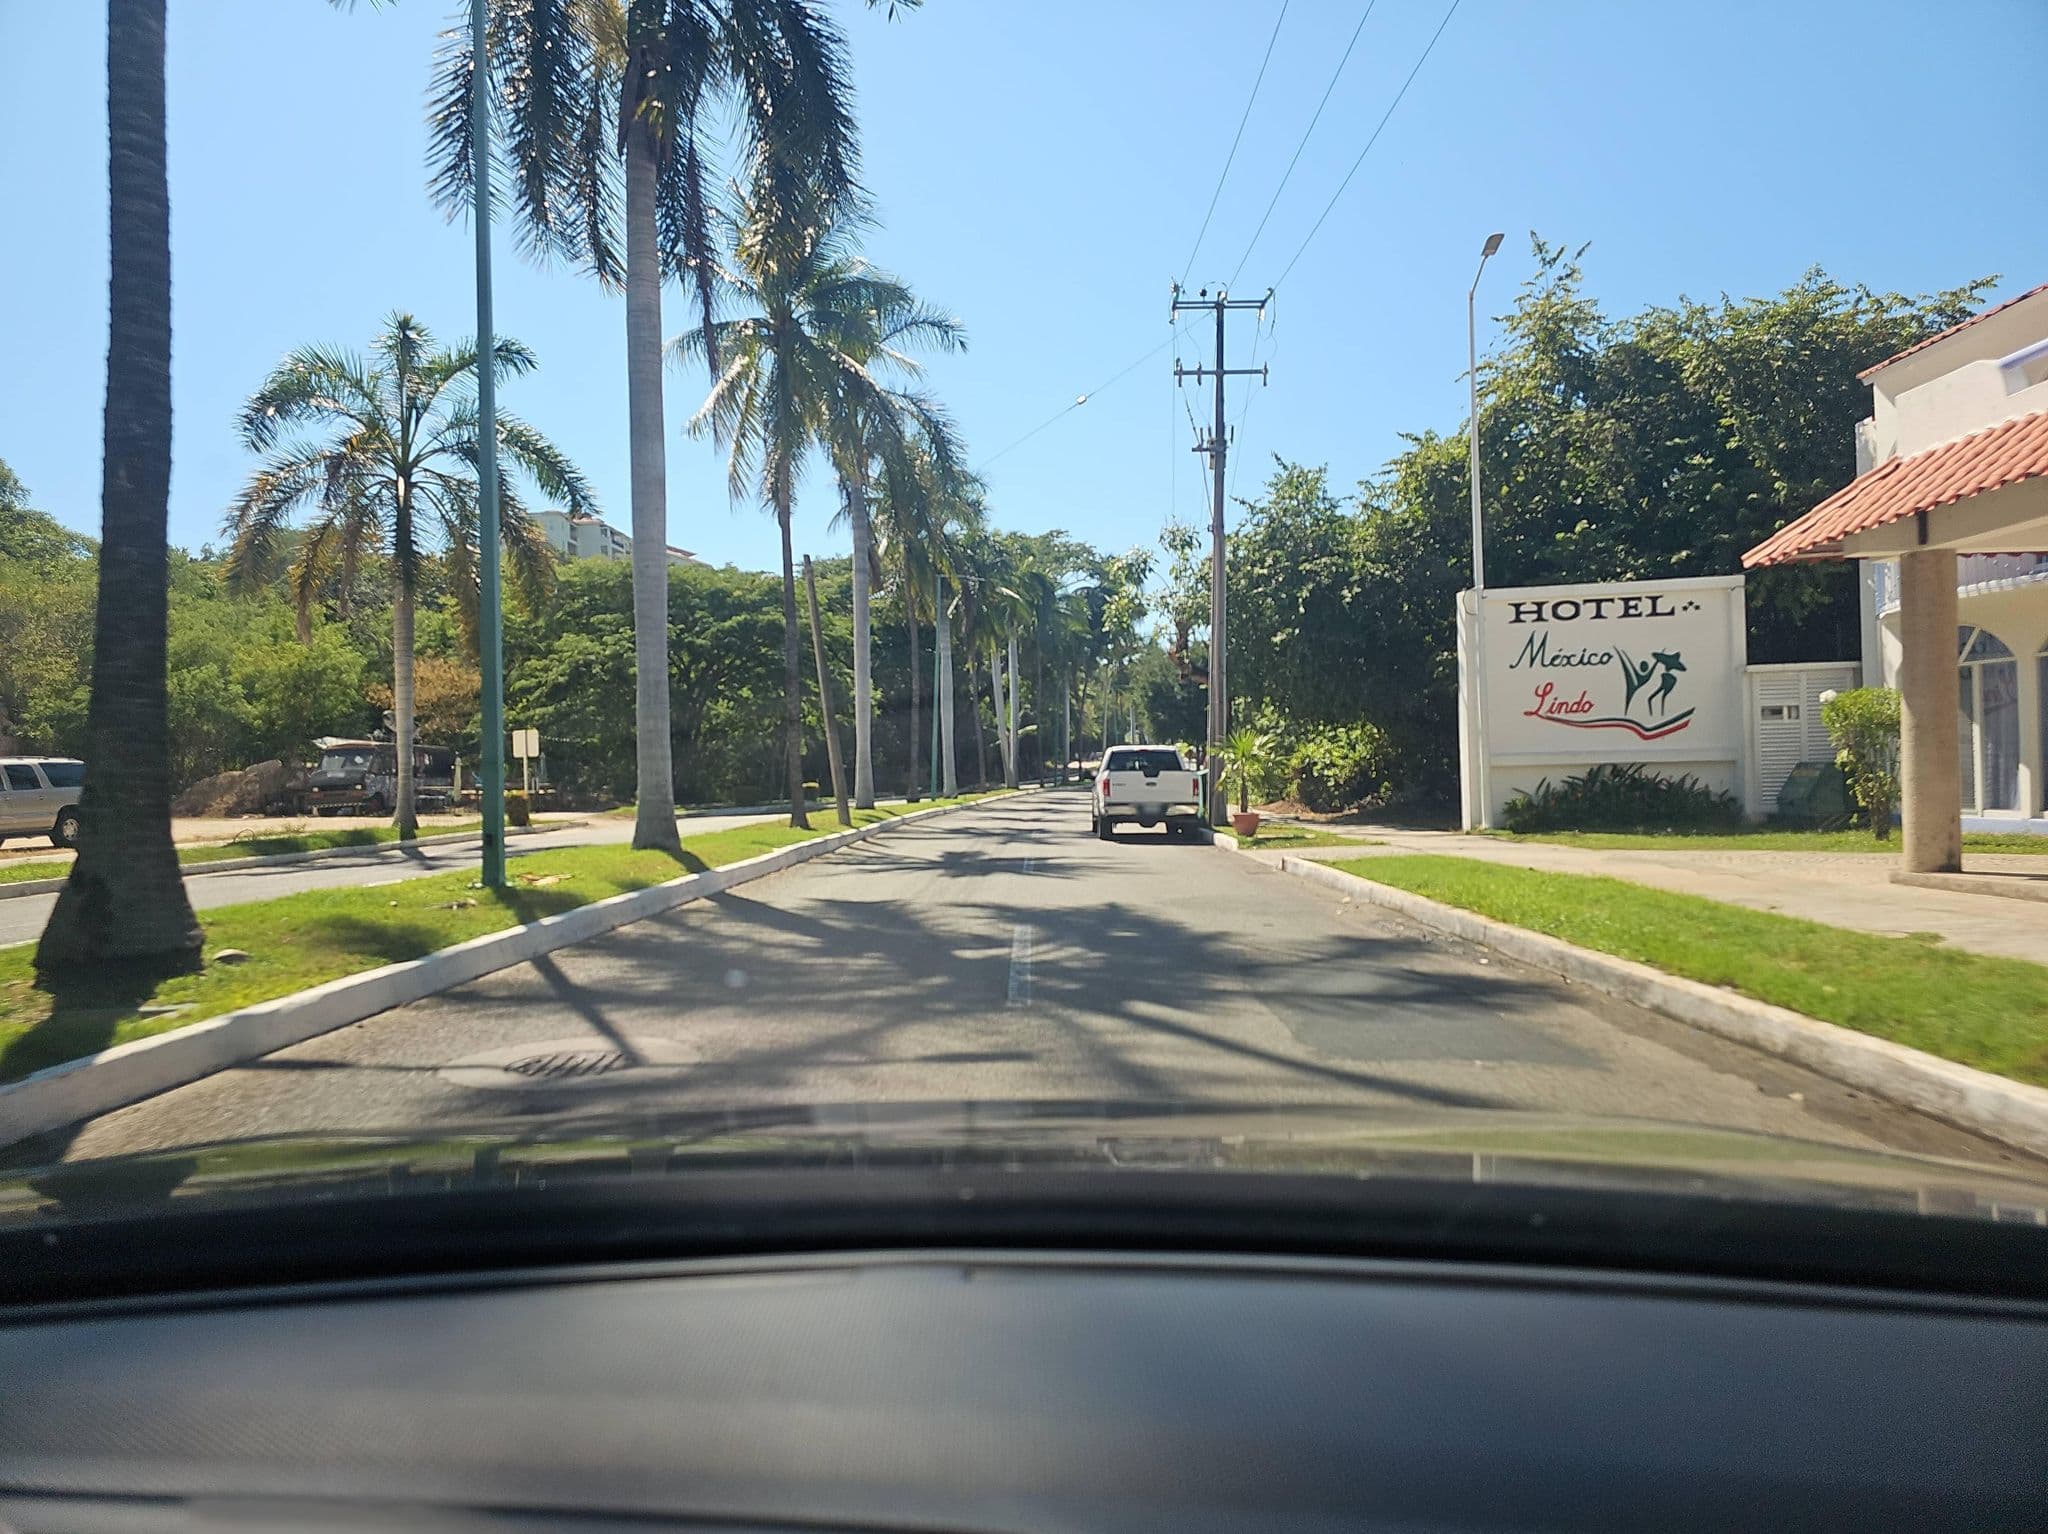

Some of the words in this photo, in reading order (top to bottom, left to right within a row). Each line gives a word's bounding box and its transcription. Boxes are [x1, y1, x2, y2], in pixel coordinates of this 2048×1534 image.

[1508, 595, 1675, 624] HOTEL
[1509, 630, 1613, 669] México
[1524, 682, 1595, 716] Lindo
